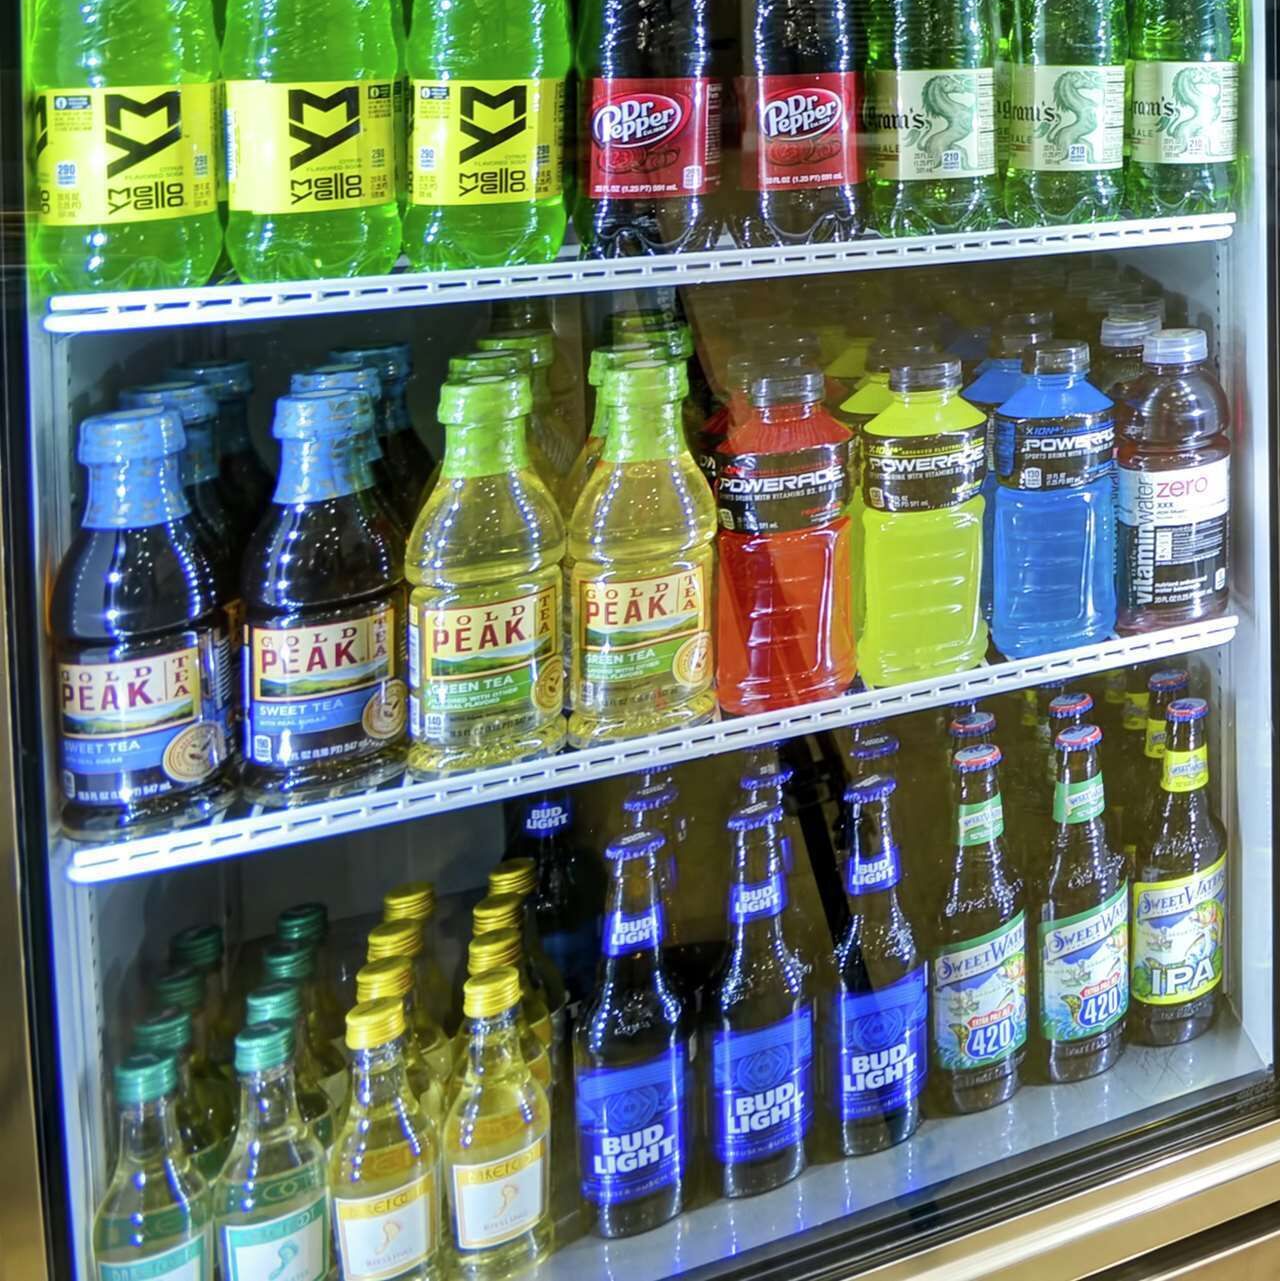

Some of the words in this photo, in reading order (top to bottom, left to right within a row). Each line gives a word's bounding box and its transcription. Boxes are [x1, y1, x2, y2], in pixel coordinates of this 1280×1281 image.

[621, 100, 654, 121] Dr
[767, 99, 837, 137] Pepper
[787, 95, 818, 116] Dr
[602, 106, 674, 143] Pepper
[943, 152, 959, 161] 210
[1070, 146, 1085, 155] 210
[869, 445, 985, 472] POWERADE
[720, 464, 845, 493] POWERADE
[1157, 477, 1208, 498] zero
[1133, 472, 1155, 604] vitaminwater
[586, 594, 668, 626] PEAK
[433, 619, 525, 653] PEAK
[261, 639, 360, 675] PEAK
[628, 647, 656, 660] TEA
[62, 679, 155, 711] PEAK
[482, 674, 514, 687] TEA
[259, 704, 306, 716] SWEET
[311, 699, 344, 712] TEA
[107, 740, 141, 752] TEA
[852, 867, 895, 886] LIGHT
[857, 859, 888, 875] BUD
[735, 895, 782, 913] LIGHT
[740, 886, 775, 903] BUD
[611, 927, 659, 947] LIGHT
[621, 917, 655, 933] BUD
[1152, 958, 1215, 995] IPA
[1084, 986, 1119, 1023] 420
[972, 1019, 1011, 1056] 420
[844, 1052, 917, 1093] LIGHT
[852, 1043, 908, 1075] BUD
[727, 1092, 804, 1135] LIGHT
[736, 1082, 794, 1116] BUD
[594, 1134, 676, 1175] LIGHT
[602, 1124, 664, 1156] BUD
